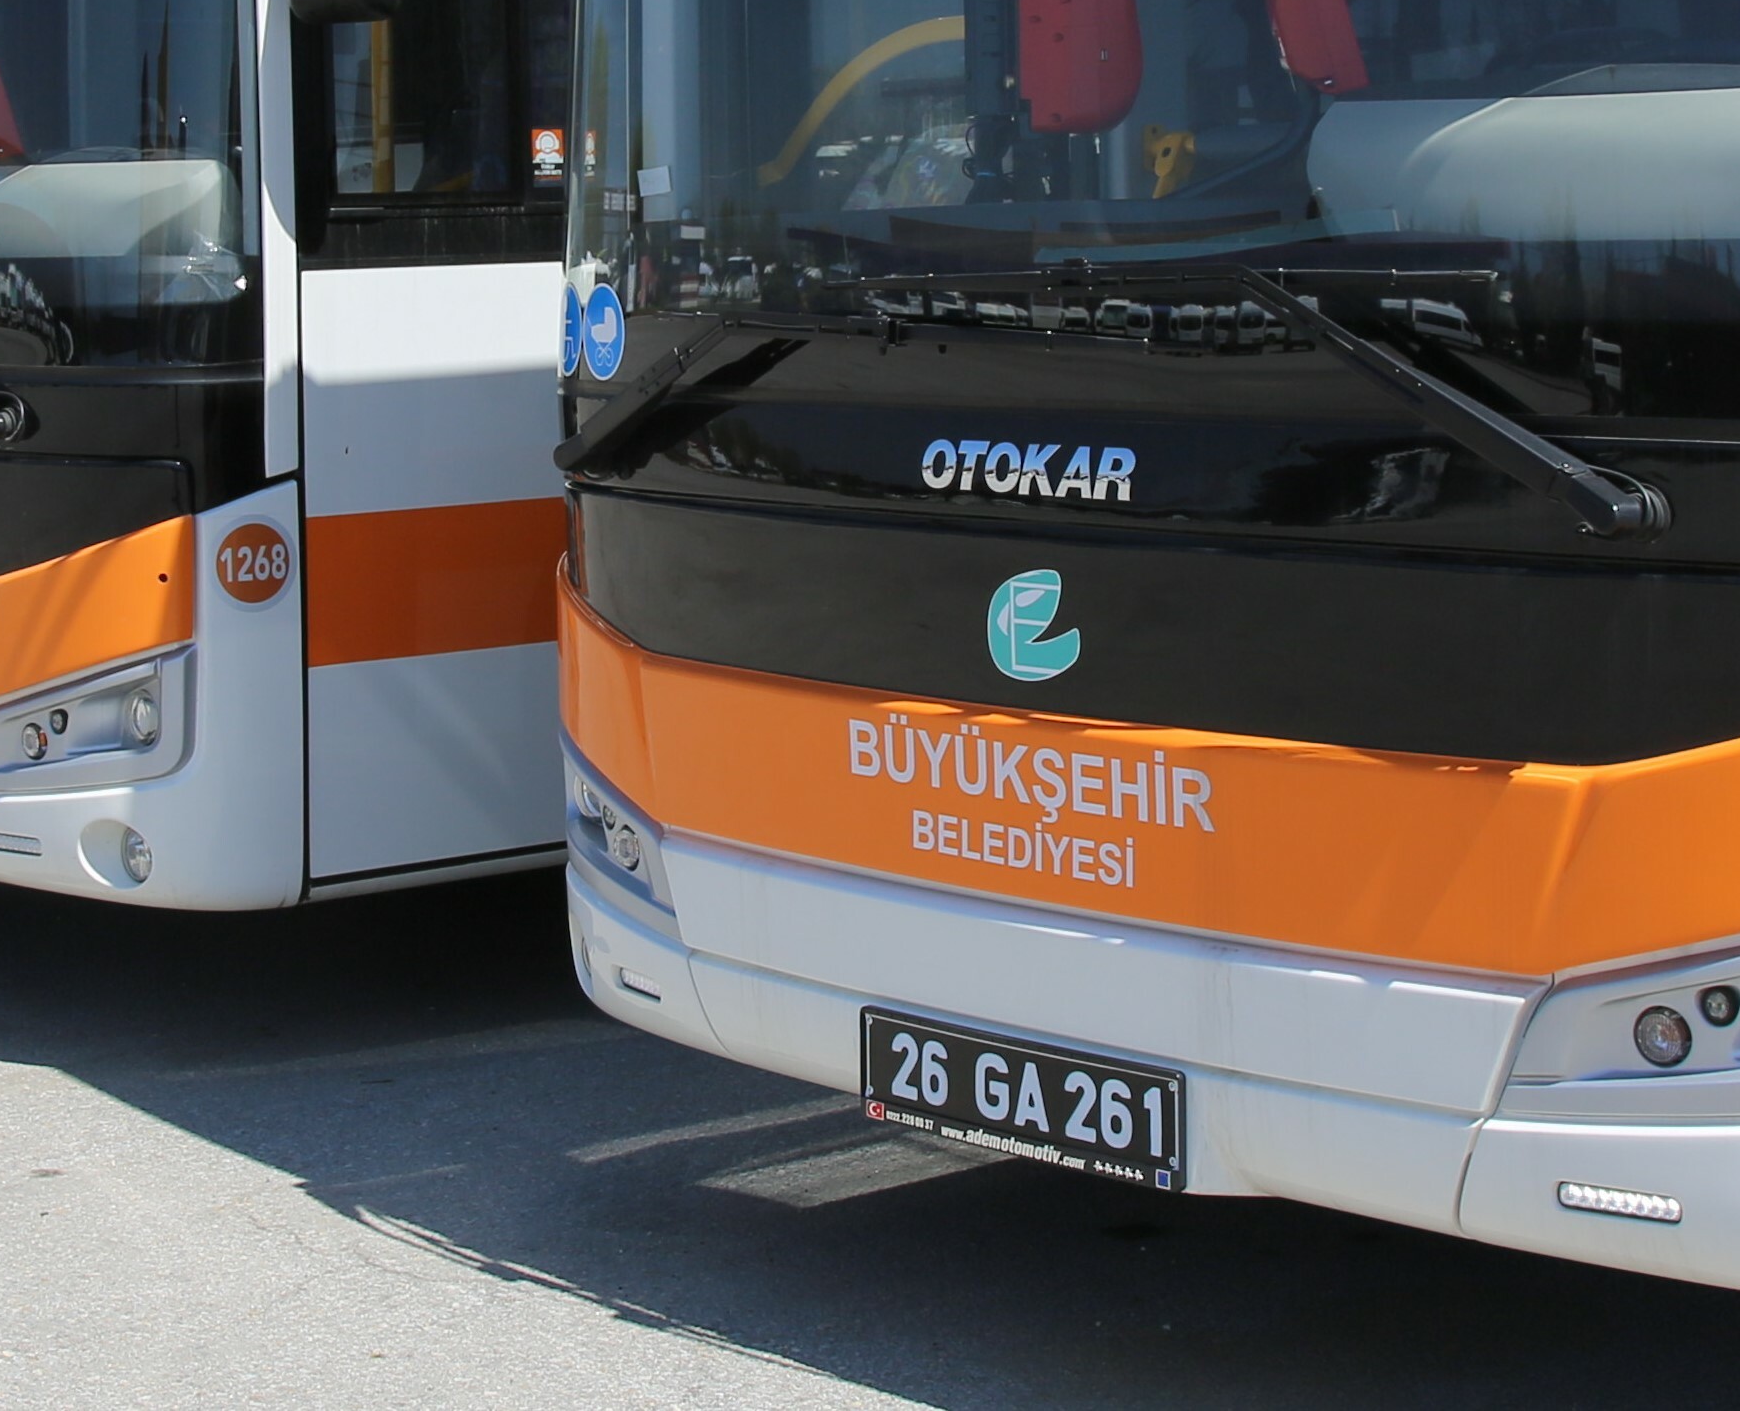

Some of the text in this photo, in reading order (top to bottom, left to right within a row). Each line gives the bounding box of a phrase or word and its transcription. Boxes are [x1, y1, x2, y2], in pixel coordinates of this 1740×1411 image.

[921, 438, 1137, 502] OTOKAR
[220, 543, 287, 583] 1268
[847, 713, 1215, 833] BÜYÜKŞEHİR
[911, 810, 1135, 889] BELEDİYESİ
[891, 1032, 1164, 1158] 26 GA 261
[940, 1125, 1087, 1171] www.ademotomotiv.com
